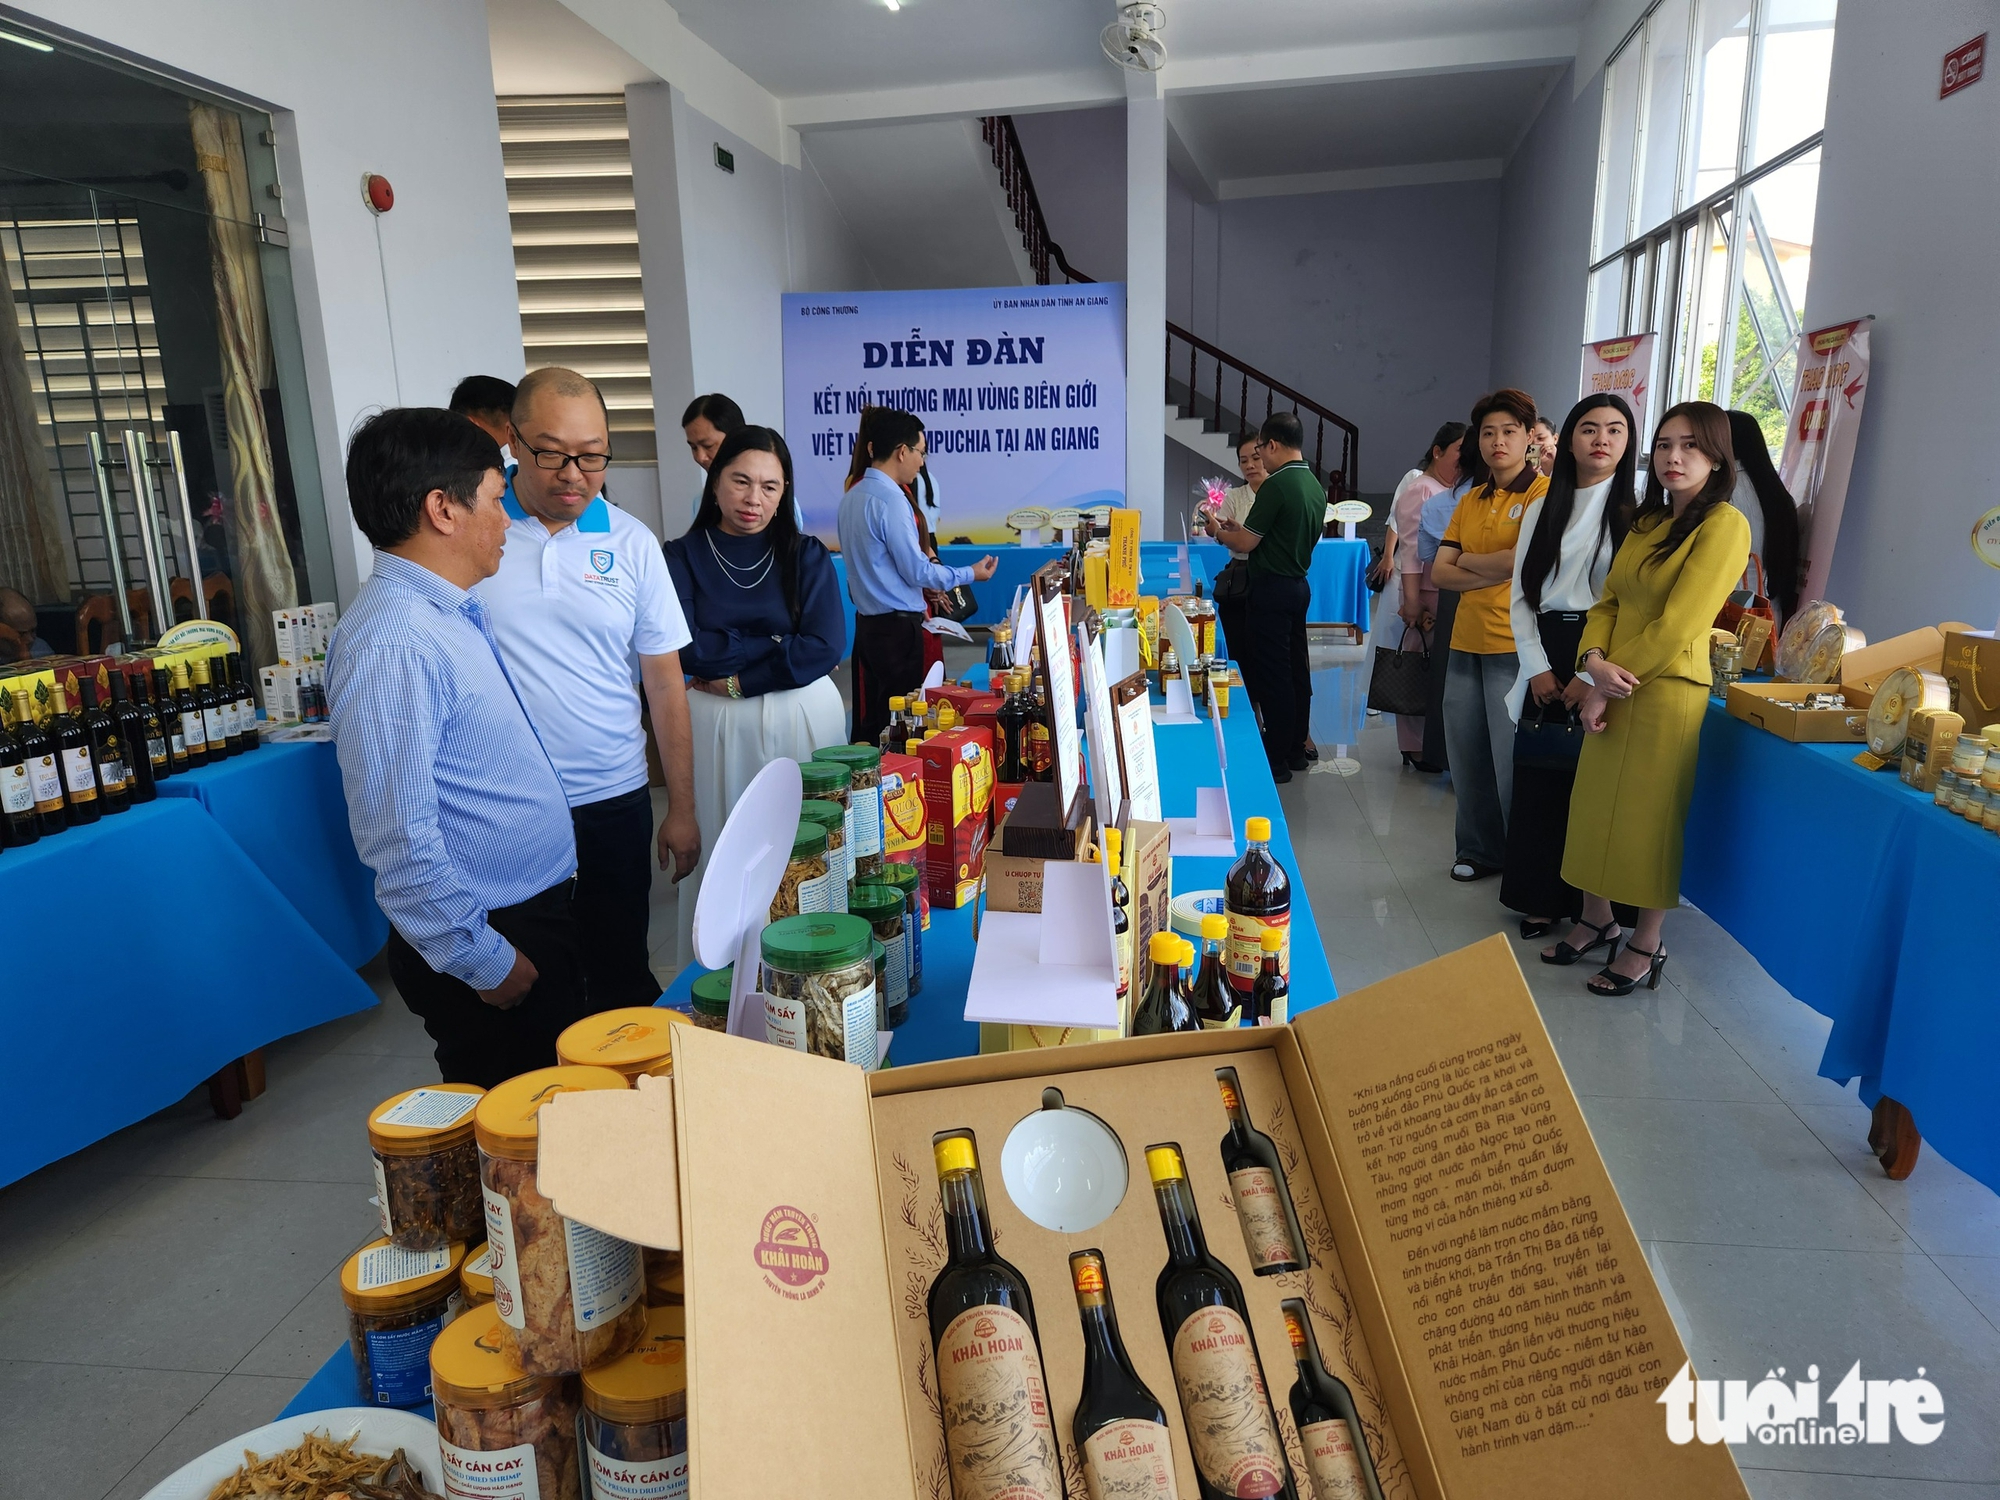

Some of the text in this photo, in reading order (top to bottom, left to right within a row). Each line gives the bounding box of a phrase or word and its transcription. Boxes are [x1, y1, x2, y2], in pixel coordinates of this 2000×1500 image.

[801, 305, 859, 317] BỘ CÔNG THƯƠNG
[1004, 299, 1018, 309] BAN
[1020, 298, 1039, 308] NHÂN
[1041, 297, 1056, 307] DÂN
[1058, 295, 1073, 307] TỈNH
[1075, 297, 1085, 306] AN
[1087, 296, 1109, 306] GIANG
[863, 327, 1045, 368] DIỄN ĐÀN
[814, 379, 1097, 417] KẾT NỐI THƯƠNG MẠI VÙNG BIÊN GIỚI
[812, 428, 844, 461] VIỆT
[996, 429, 1019, 457] TẠI
[1024, 427, 1046, 451] AN
[1051, 426, 1099, 451] GIANG
[778, 1006, 796, 1020] SẤY
[1374, 1082, 1387, 1093] tia
[1389, 1072, 1414, 1088] nắng
[1415, 1061, 1437, 1078] cuối
[1438, 1053, 1464, 1069] cùng
[1466, 1043, 1493, 1058] trong
[1495, 1032, 1521, 1048] ngày
[1347, 1044, 1527, 1118] buông xuống cũng là lúc các tàu cá
[1352, 1057, 1533, 1131] trên biển đảo Phú Quốc ra khơi và
[1357, 1072, 1538, 1144] trở về với khoang tàu đầy ắp cá cơm
[1361, 1084, 1544, 1157] than. Từ nguồn cá cơm than sẵn có
[760, 1248, 823, 1271] KHẢI HOÀN
[952, 1334, 1023, 1364] KHẢI HOÀN
[1191, 1332, 1246, 1353] KHẢI HOÀN
[1433, 1307, 1639, 1373] Khải Hoàn, gắn liền với thương hiệu
[1439, 1373, 1466, 1389] nước
[1469, 1364, 1498, 1381] mắm
[1501, 1355, 1525, 1372] Phú
[1528, 1345, 1561, 1364] Quốc
[1573, 1335, 1603, 1352] niềm
[1606, 1330, 1619, 1343] tự
[1622, 1324, 1646, 1338] hào
[447, 1453, 524, 1473] SẤY CÁN CAY.
[1104, 1442, 1155, 1462] KHẢI HOÀN
[465, 1472, 521, 1483] DRIED SHRIMP
[593, 1458, 689, 1484] TÔM SẤY CÁN CA
[1252, 1470, 1263, 1482] 45
[506, 1481, 523, 1490] HẠNG
[608, 1483, 638, 1494] PRESSED
[640, 1486, 665, 1495] DRIED
[666, 1479, 689, 1490] SHRI
